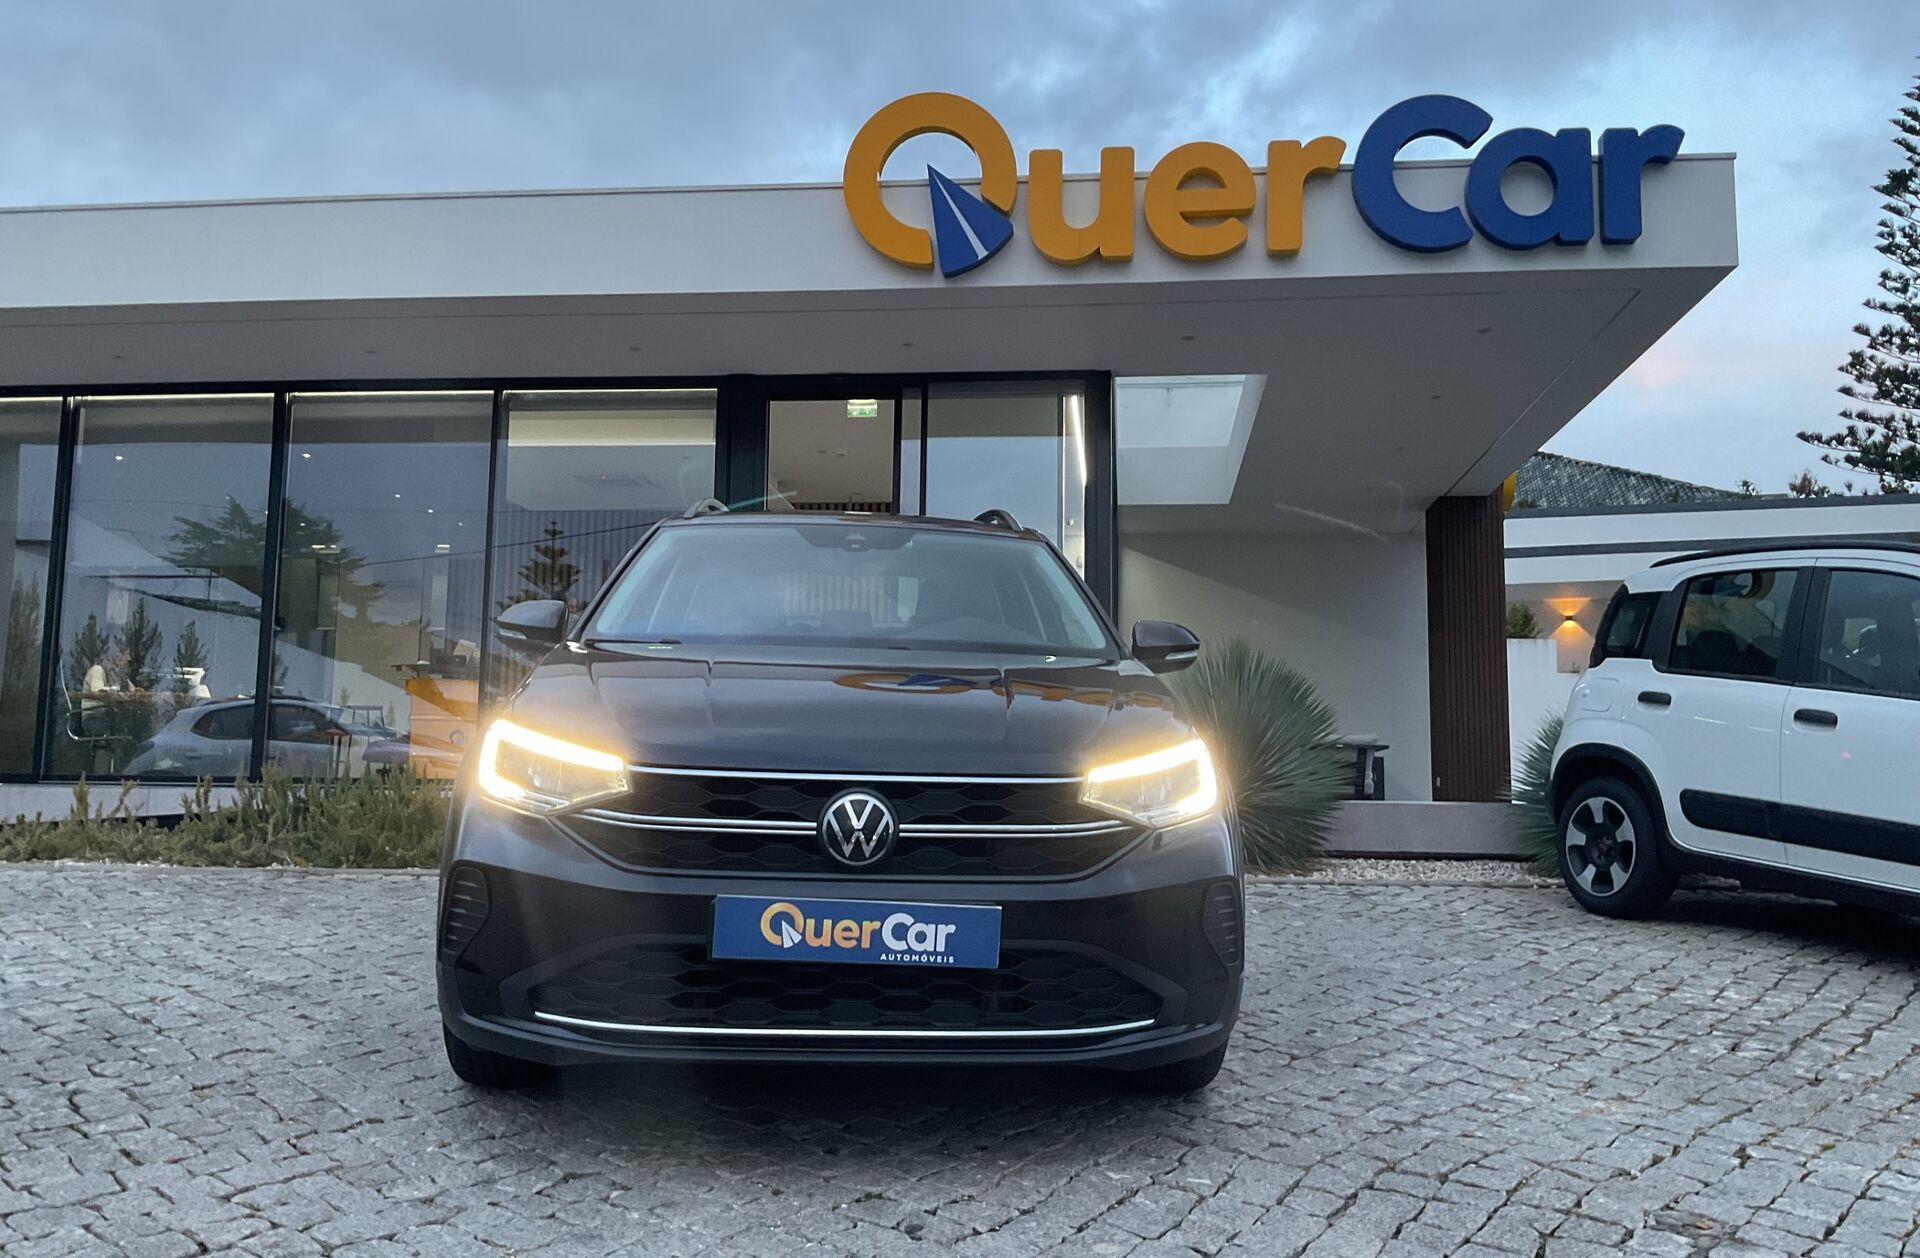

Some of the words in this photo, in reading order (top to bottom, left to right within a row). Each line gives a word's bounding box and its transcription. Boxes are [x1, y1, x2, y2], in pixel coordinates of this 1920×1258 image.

[843, 91, 1684, 278] QuerCar
[760, 902, 956, 952] QuerCar
[880, 953, 954, 963] AUTOMÓVEIS
